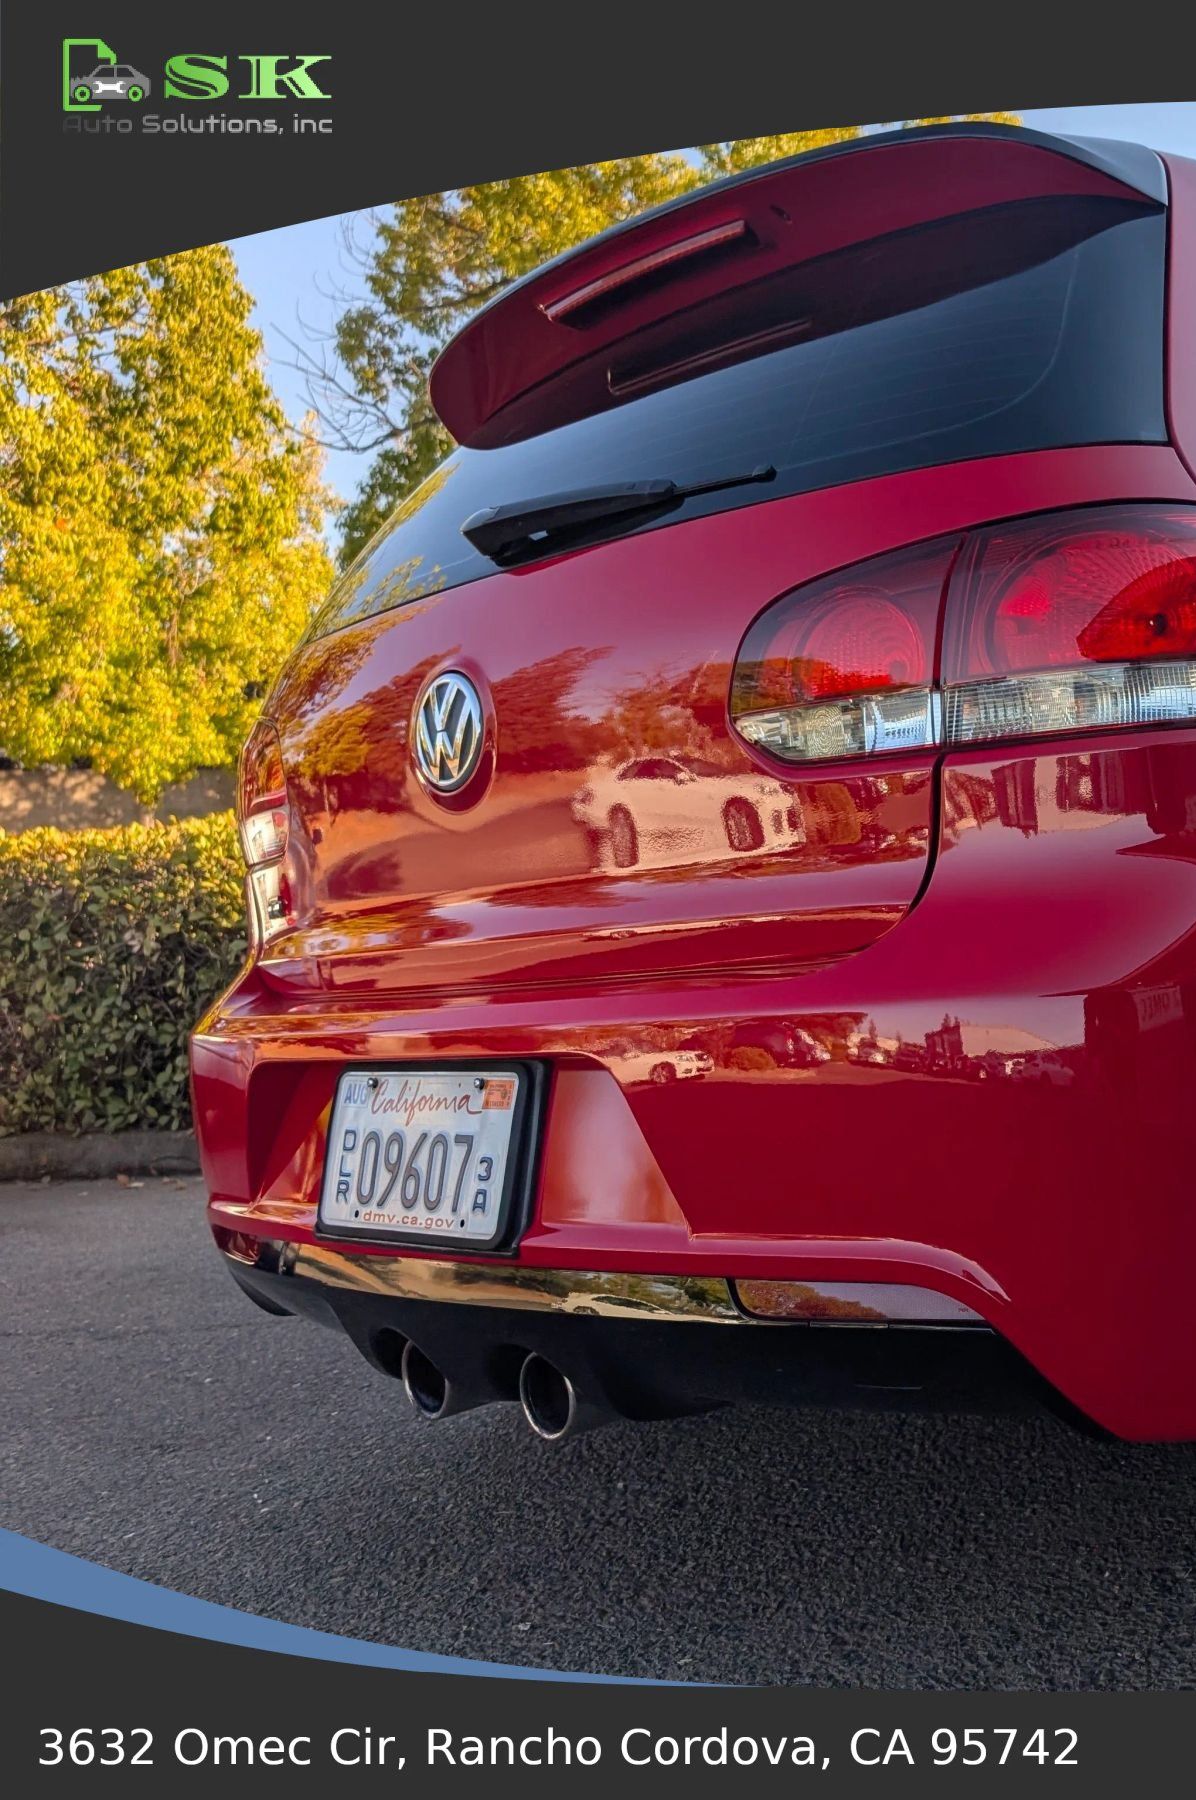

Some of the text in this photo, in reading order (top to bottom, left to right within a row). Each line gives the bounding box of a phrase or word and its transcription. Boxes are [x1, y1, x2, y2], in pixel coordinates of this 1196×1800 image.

[371, 1079, 482, 1127] California
[357, 1131, 474, 1213] 09607
[363, 1210, 455, 1229] dmv.ca.gov
